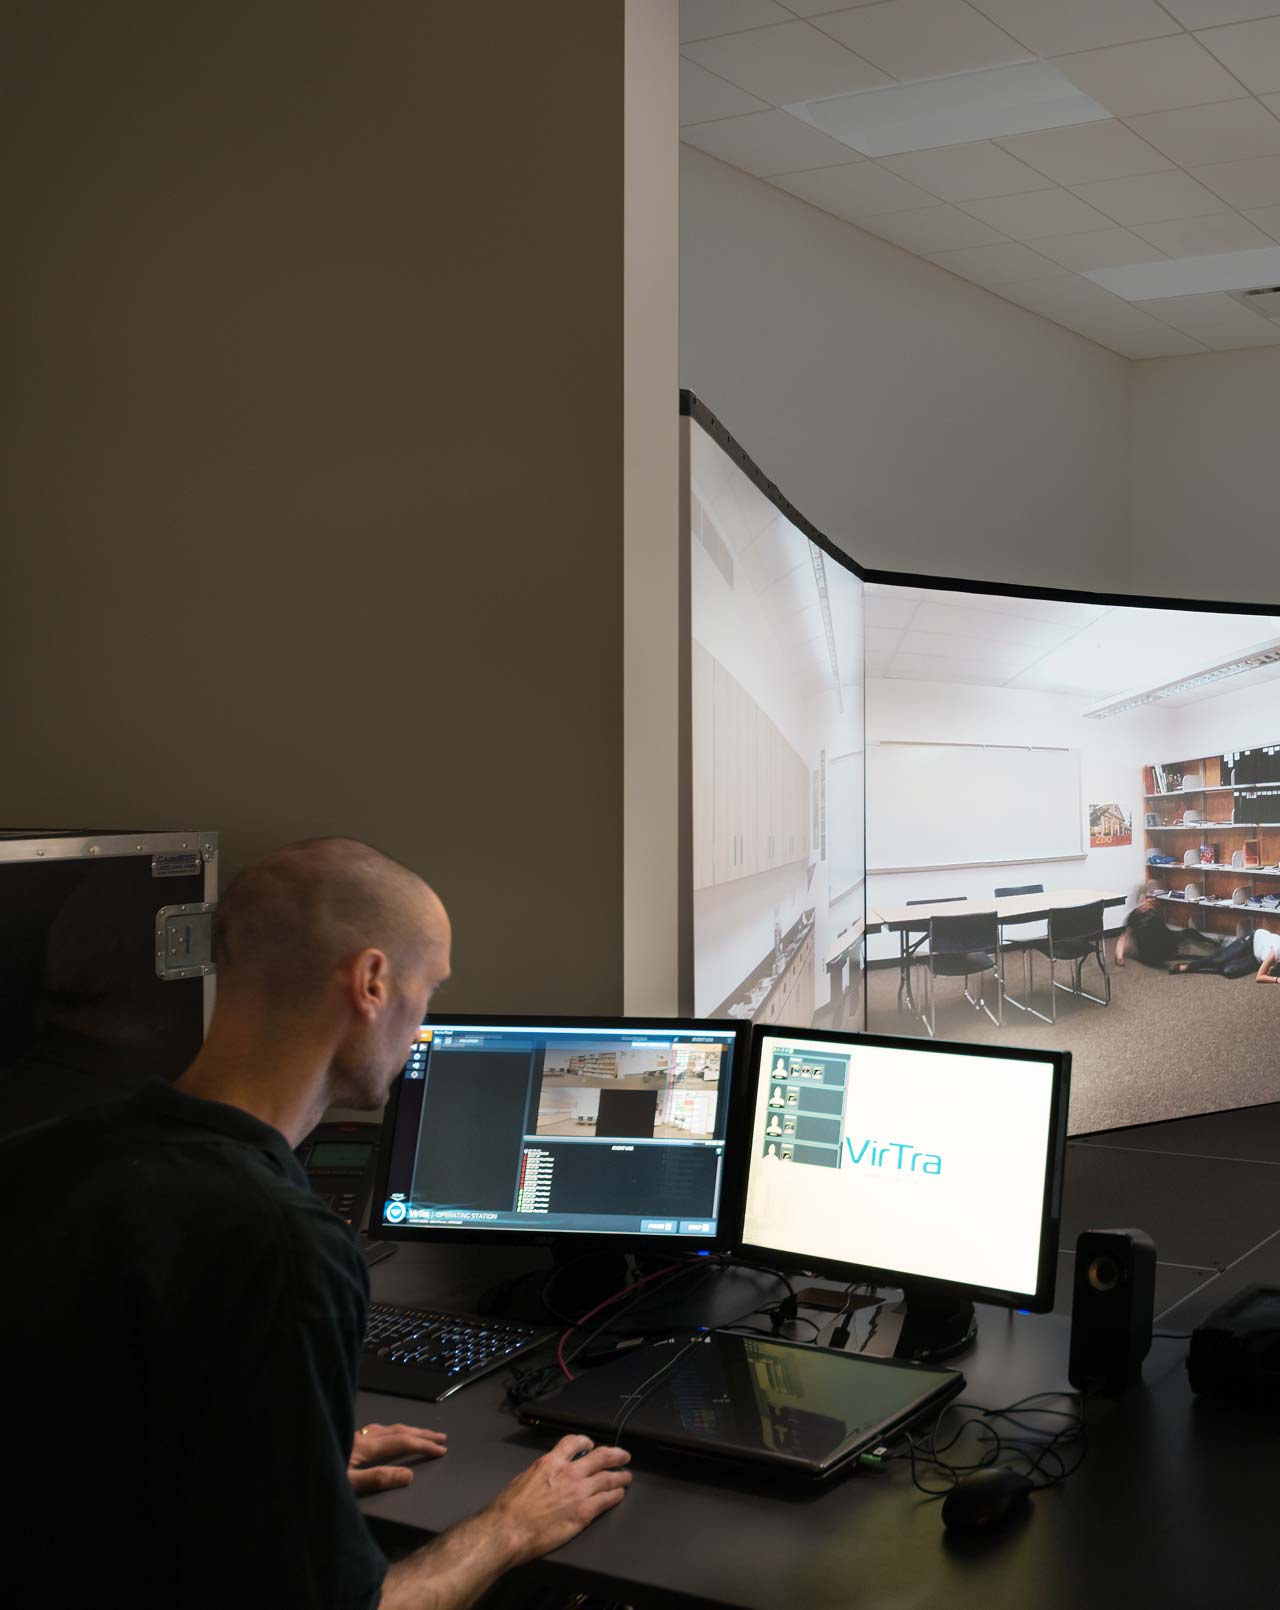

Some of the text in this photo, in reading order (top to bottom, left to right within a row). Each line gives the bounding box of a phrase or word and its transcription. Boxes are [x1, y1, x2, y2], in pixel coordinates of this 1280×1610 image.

[846, 1136, 942, 1175] VirTra
[436, 1211, 470, 1219] OPERATING
[470, 1212, 498, 1220] STATION
